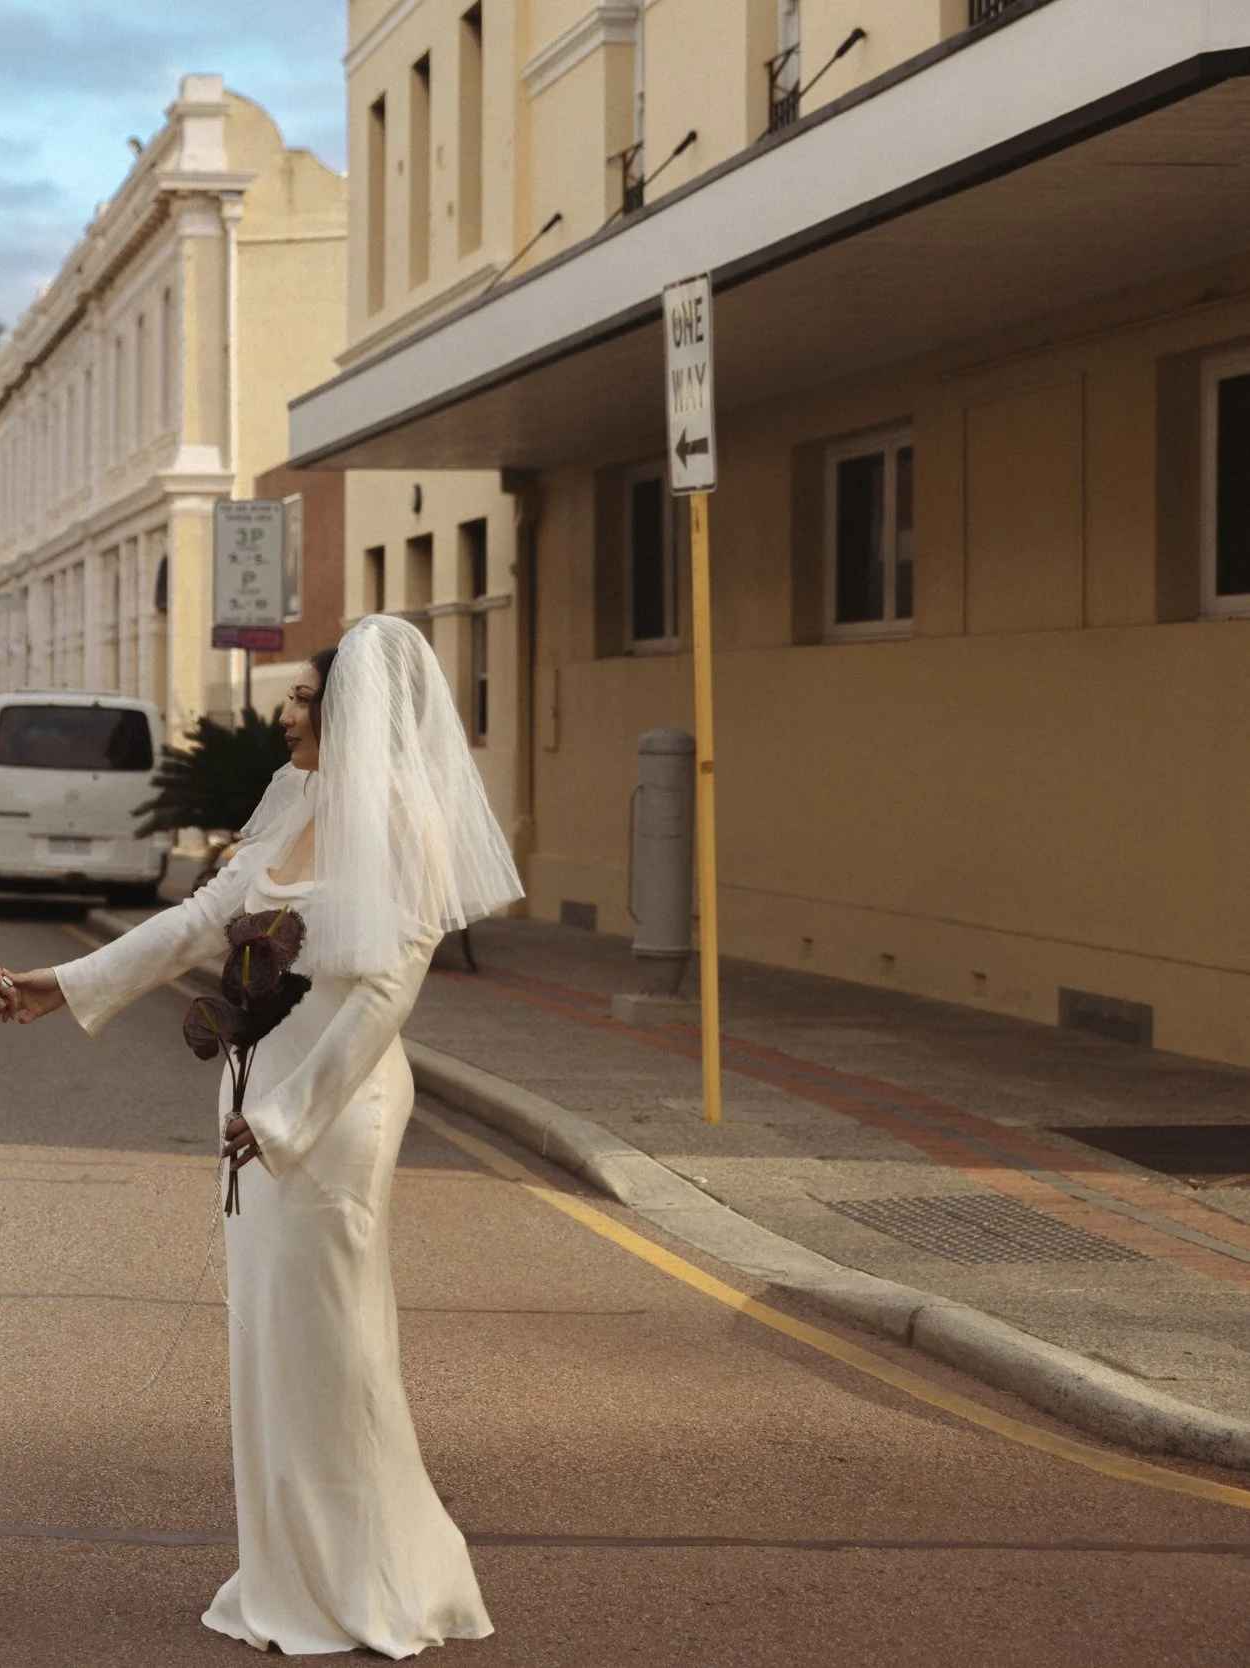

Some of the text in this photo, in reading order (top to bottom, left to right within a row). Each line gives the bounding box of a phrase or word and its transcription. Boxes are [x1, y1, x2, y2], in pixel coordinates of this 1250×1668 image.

[672, 297, 704, 348] ONE
[672, 362, 706, 413] WAY
[234, 527, 265, 547] 3P
